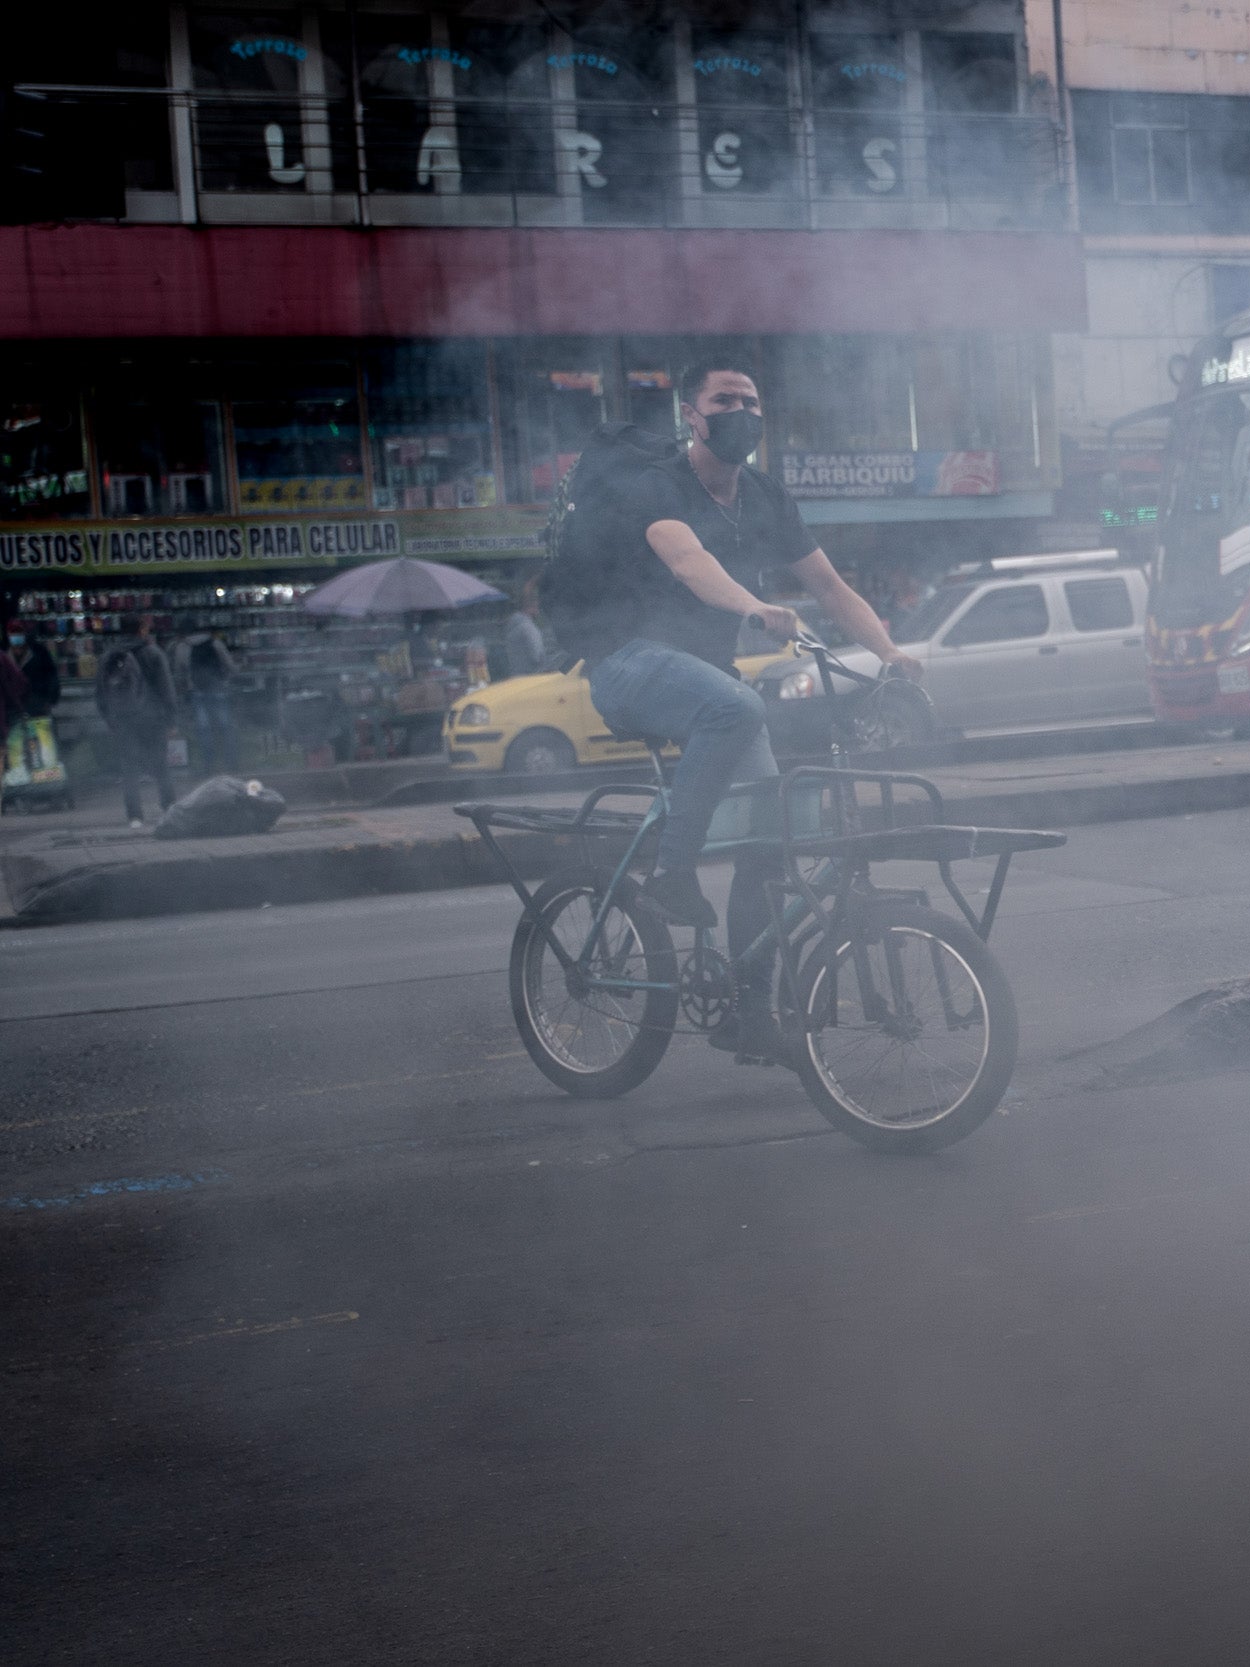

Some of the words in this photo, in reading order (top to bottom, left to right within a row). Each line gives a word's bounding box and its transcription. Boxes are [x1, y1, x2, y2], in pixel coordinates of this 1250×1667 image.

[783, 467, 916, 485] BARBIQUIU
[0, 533, 83, 566] UESTOS
[87, 531, 103, 563] Y
[110, 527, 241, 562] ACCESORIOS
[249, 526, 301, 557] PARA
[310, 523, 398, 554] CELULAR
